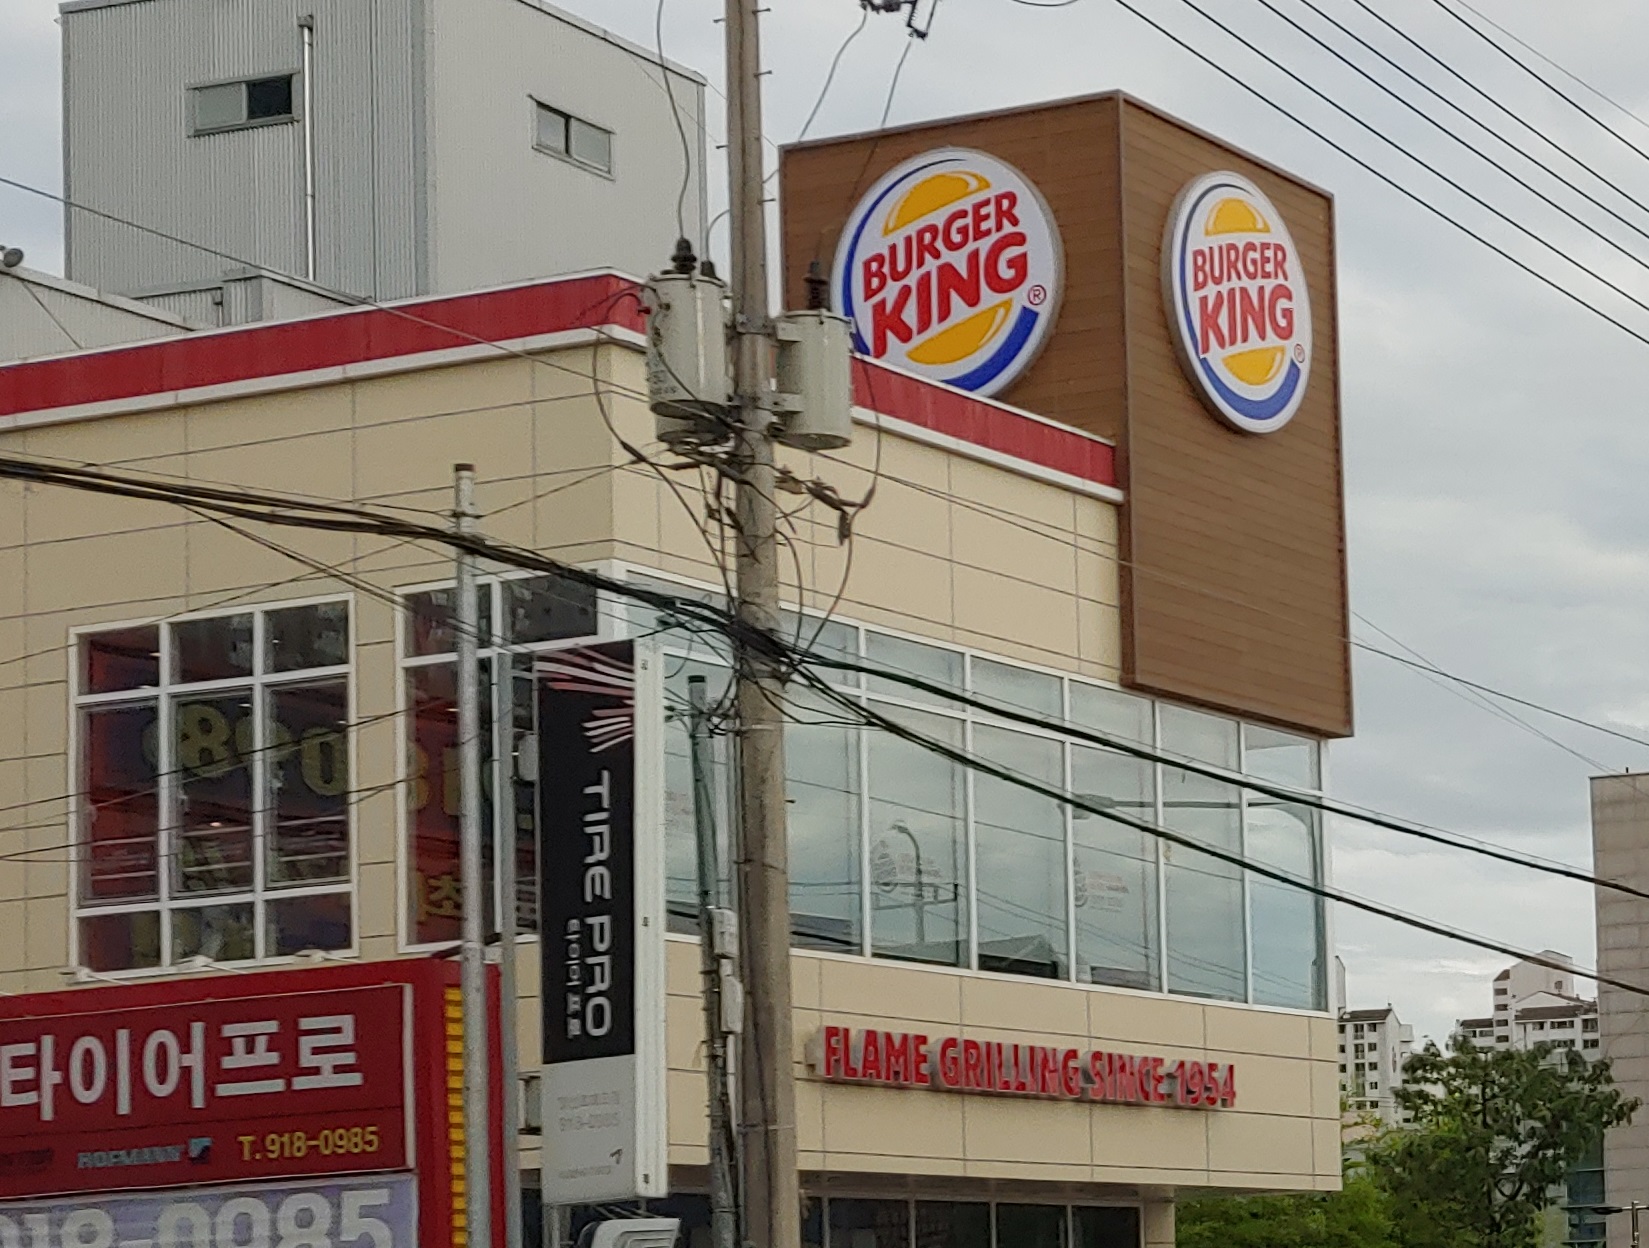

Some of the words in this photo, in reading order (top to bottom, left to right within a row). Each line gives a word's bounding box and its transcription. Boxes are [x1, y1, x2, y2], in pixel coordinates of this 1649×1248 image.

[862, 190, 1021, 302] BURGER
[872, 231, 1029, 360] KING
[1192, 242, 1288, 292] BURGER
[1199, 284, 1294, 355] KING
[583, 768, 612, 904] TIRE
[584, 914, 613, 1038] PRO
[0, 1013, 364, 1121] 타이어프로
[823, 1025, 933, 1086] FLAME
[938, 1036, 1083, 1099] GRILLING
[1088, 1049, 1169, 1104] SINCE
[1172, 1058, 1239, 1109] 1954
